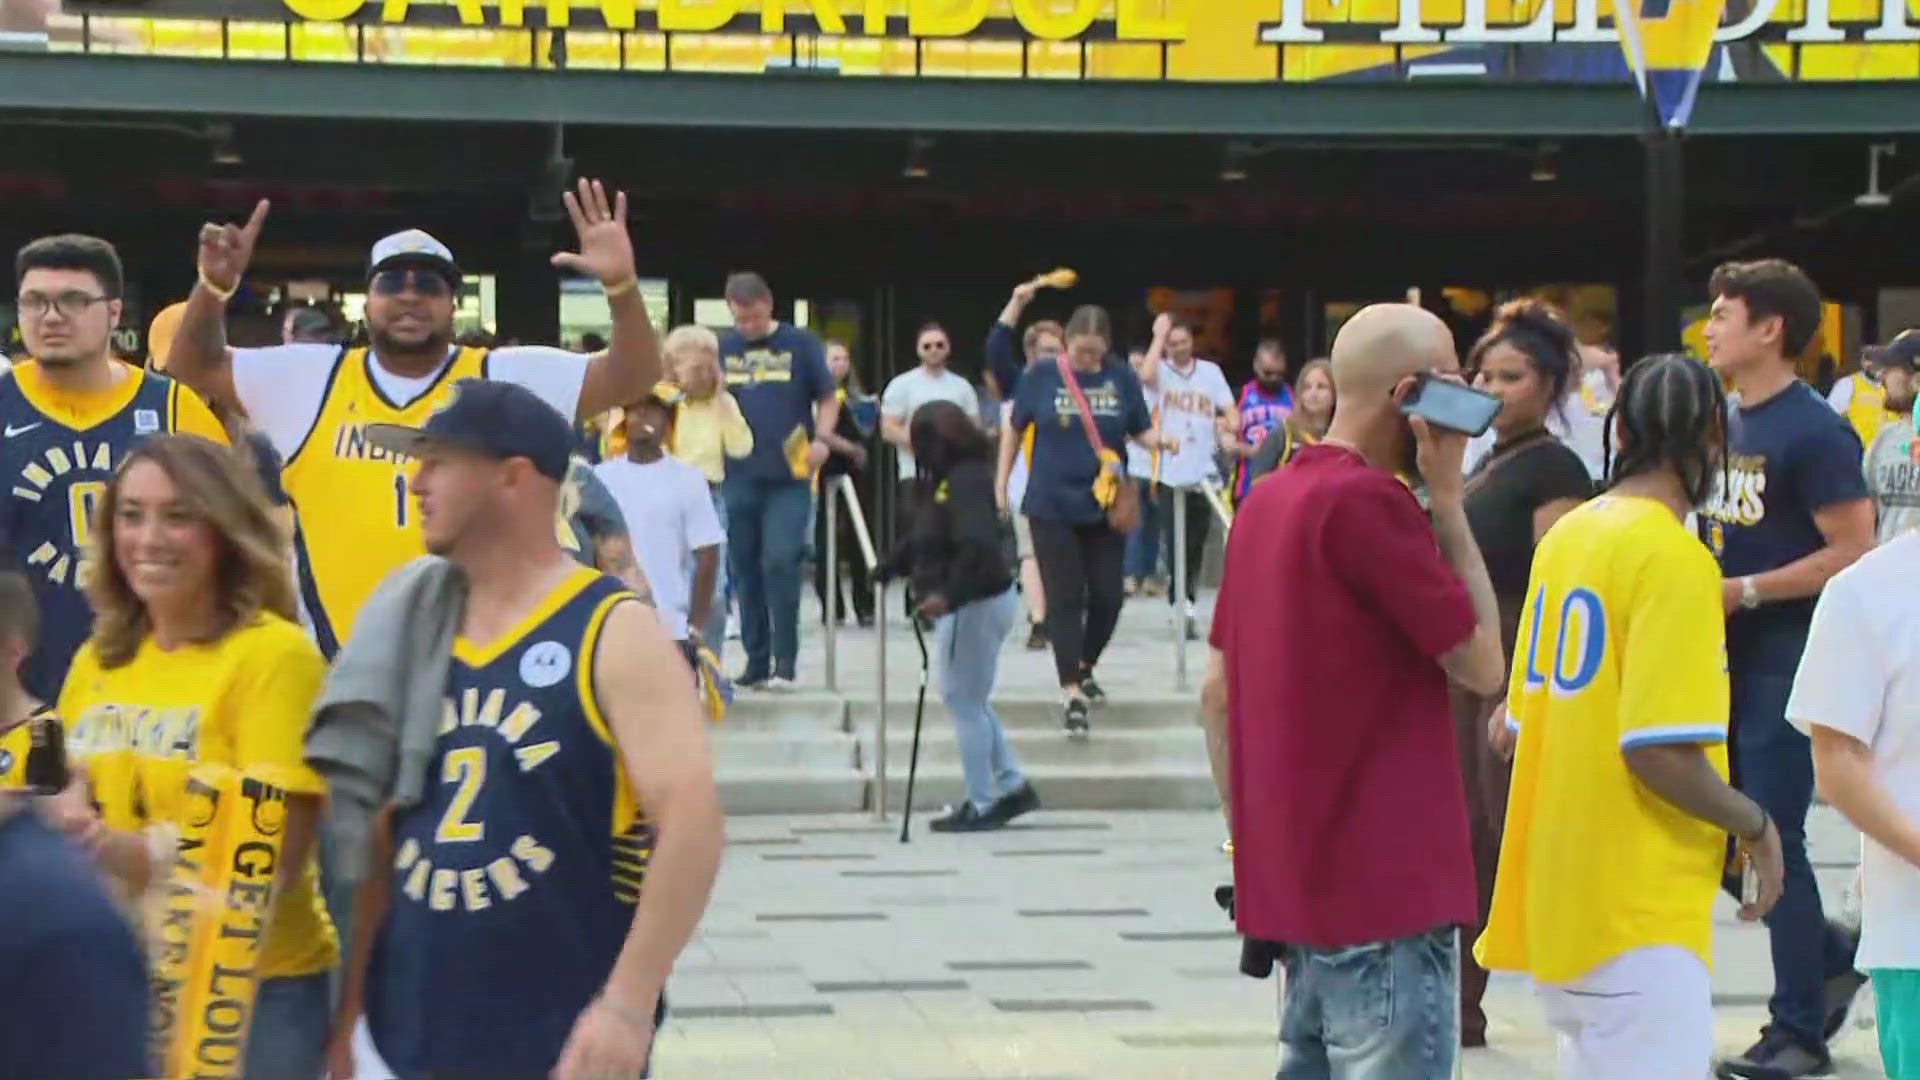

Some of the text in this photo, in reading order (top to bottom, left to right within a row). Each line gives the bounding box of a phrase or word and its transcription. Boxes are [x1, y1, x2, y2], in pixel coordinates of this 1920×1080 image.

[12, 440, 132, 502] INDIA
[1523, 583, 1606, 697] 10
[437, 687, 561, 772] DIANA
[434, 746, 487, 843] 2
[194, 840, 275, 1080] GET LOU
